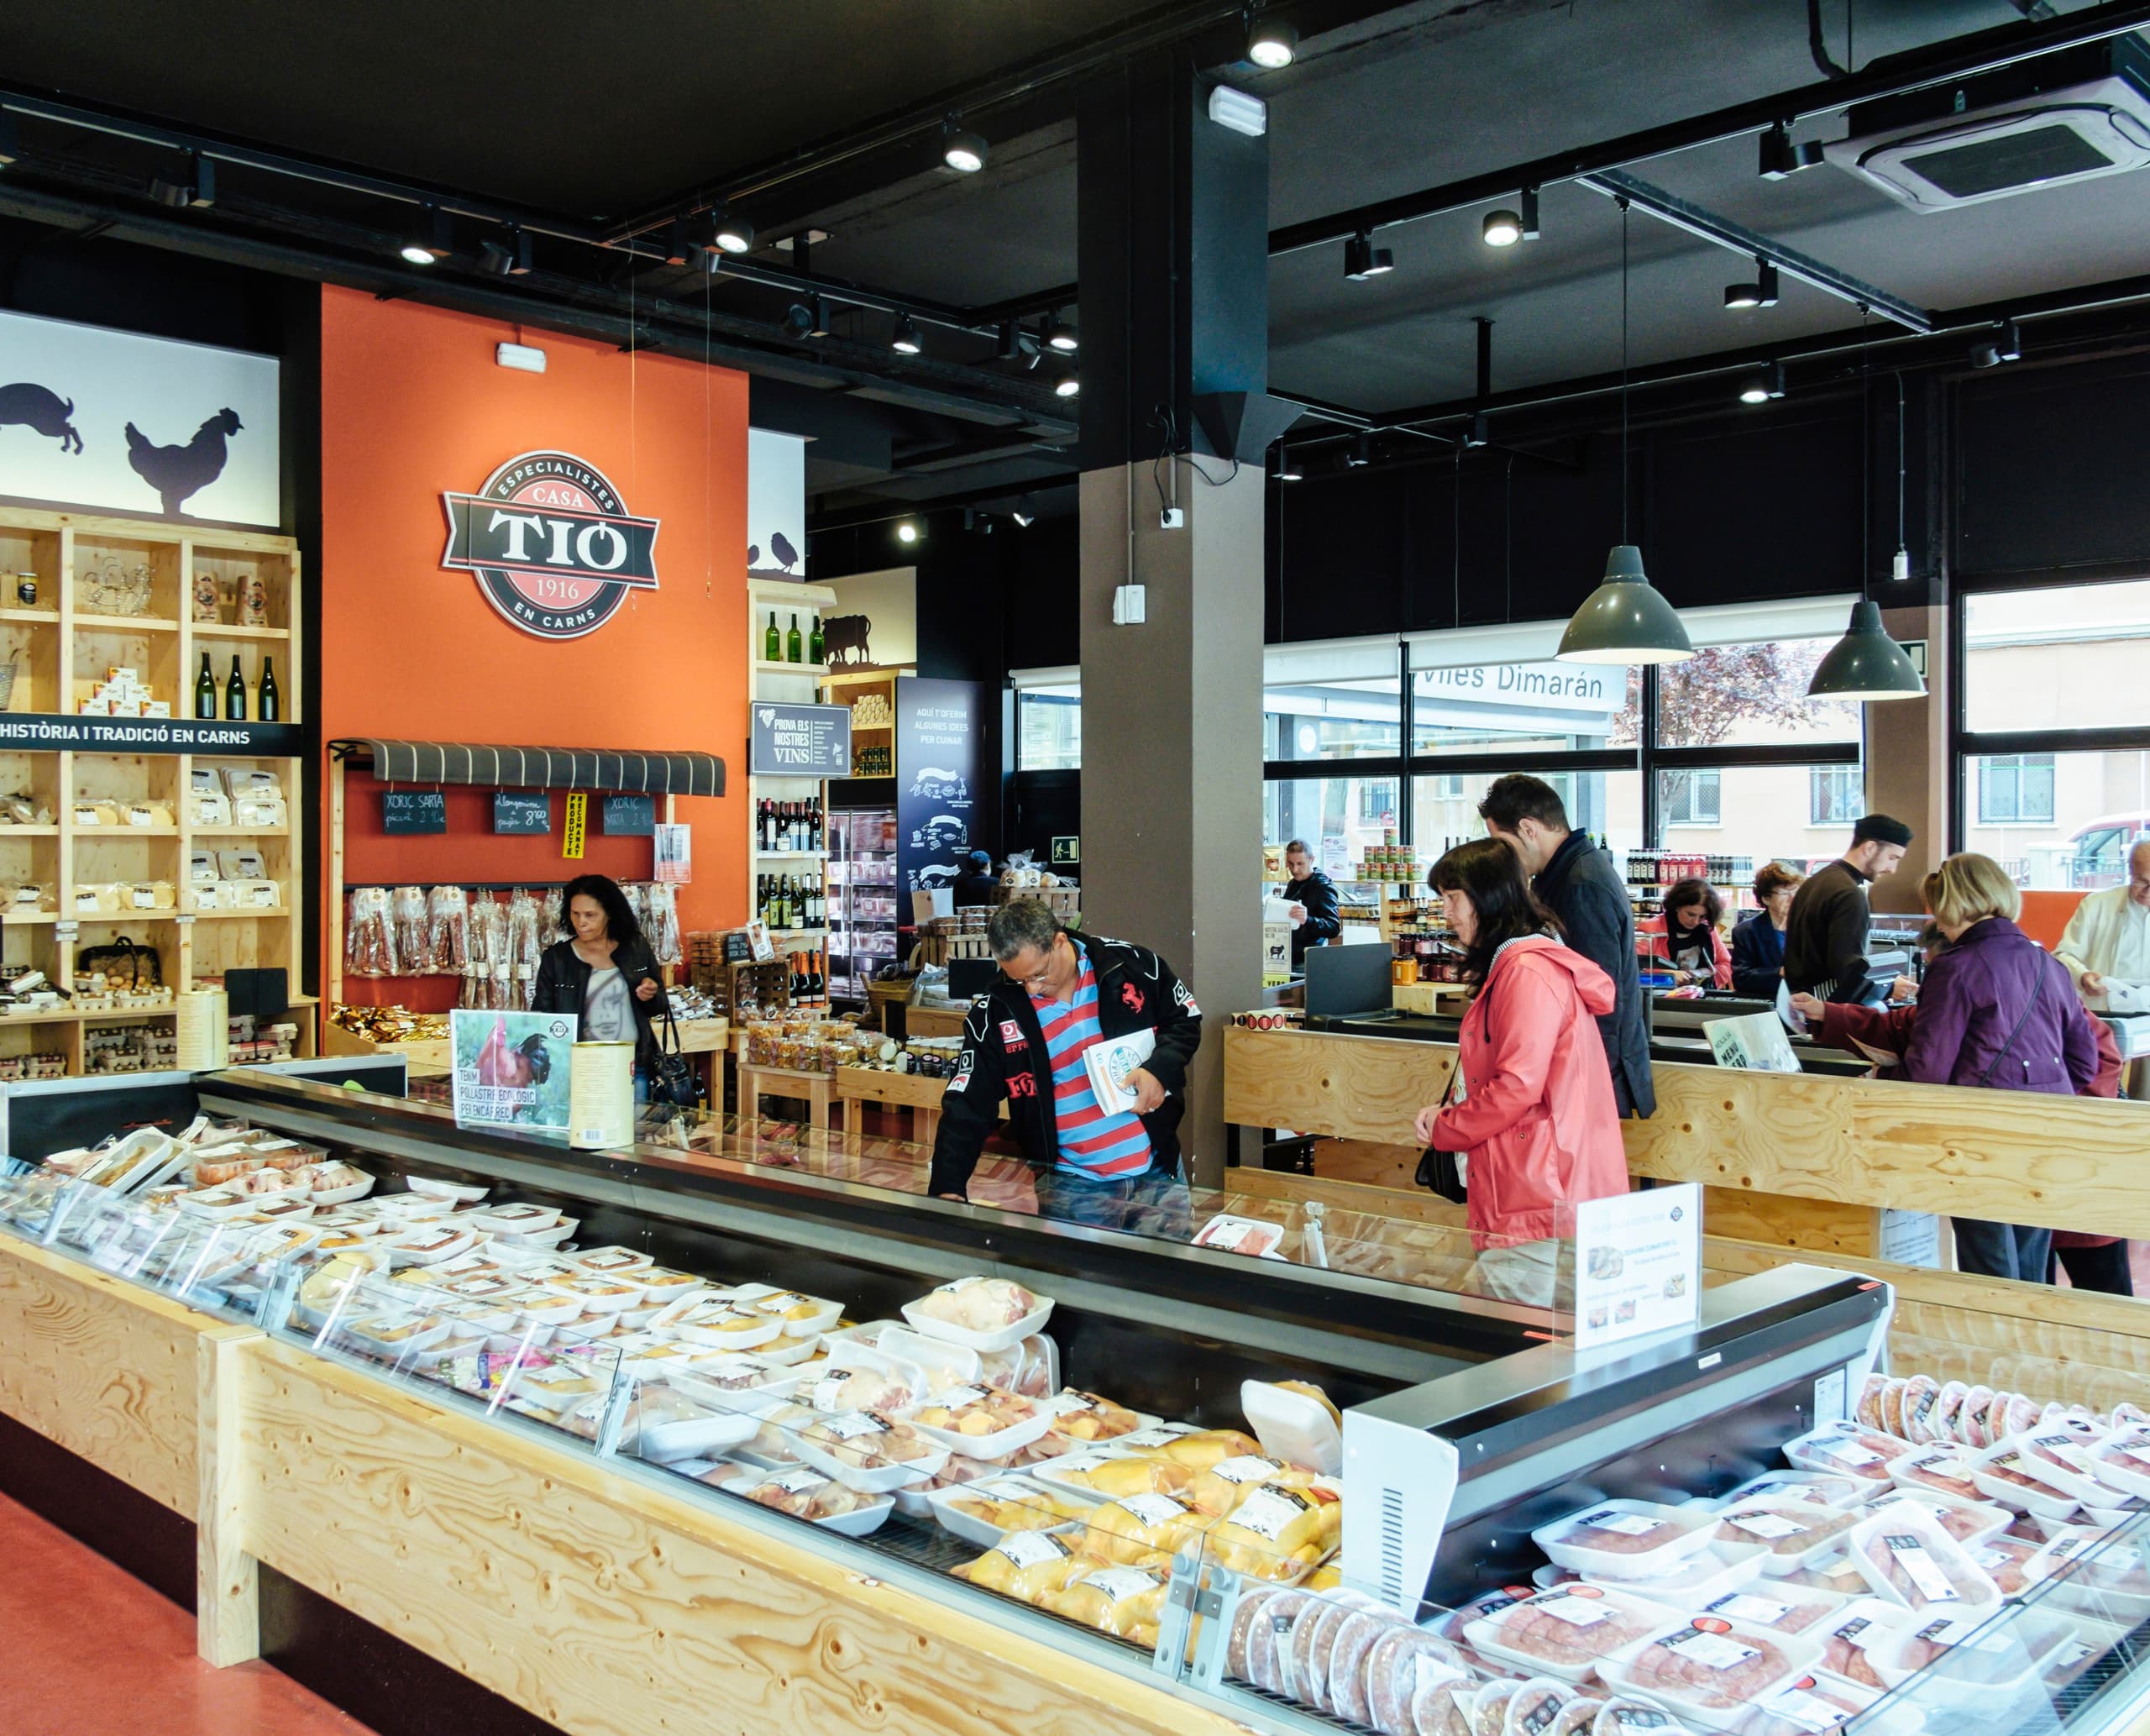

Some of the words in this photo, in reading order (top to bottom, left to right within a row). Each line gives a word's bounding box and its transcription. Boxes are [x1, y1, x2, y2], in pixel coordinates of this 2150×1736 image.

[497, 461, 614, 510] ESPECIALISTES
[532, 487, 584, 508] CASA
[536, 579, 579, 600] 1916
[513, 601, 536, 621] EN
[543, 609, 595, 628] CARNS
[1498, 665, 1602, 699] Dimarán
[0, 721, 80, 740] HISTÒRIA
[83, 727, 89, 740] I
[92, 725, 168, 742] TRADICIÓ
[172, 729, 194, 743] EN
[197, 730, 250, 744] CARNS
[774, 719, 796, 731] PROVA
[797, 720, 809, 731] ELS
[915, 721, 944, 731] ALGUNES
[946, 722, 968, 732] IDEES
[774, 732, 810, 747] NOSTRES
[920, 735, 933, 744] PER
[936, 735, 962, 746] CUINAR
[773, 747, 810, 763] VINS
[566, 795, 575, 855] PRODUCTE
[574, 796, 583, 857] RECOMANAT
[459, 1069, 478, 1082] TENIM
